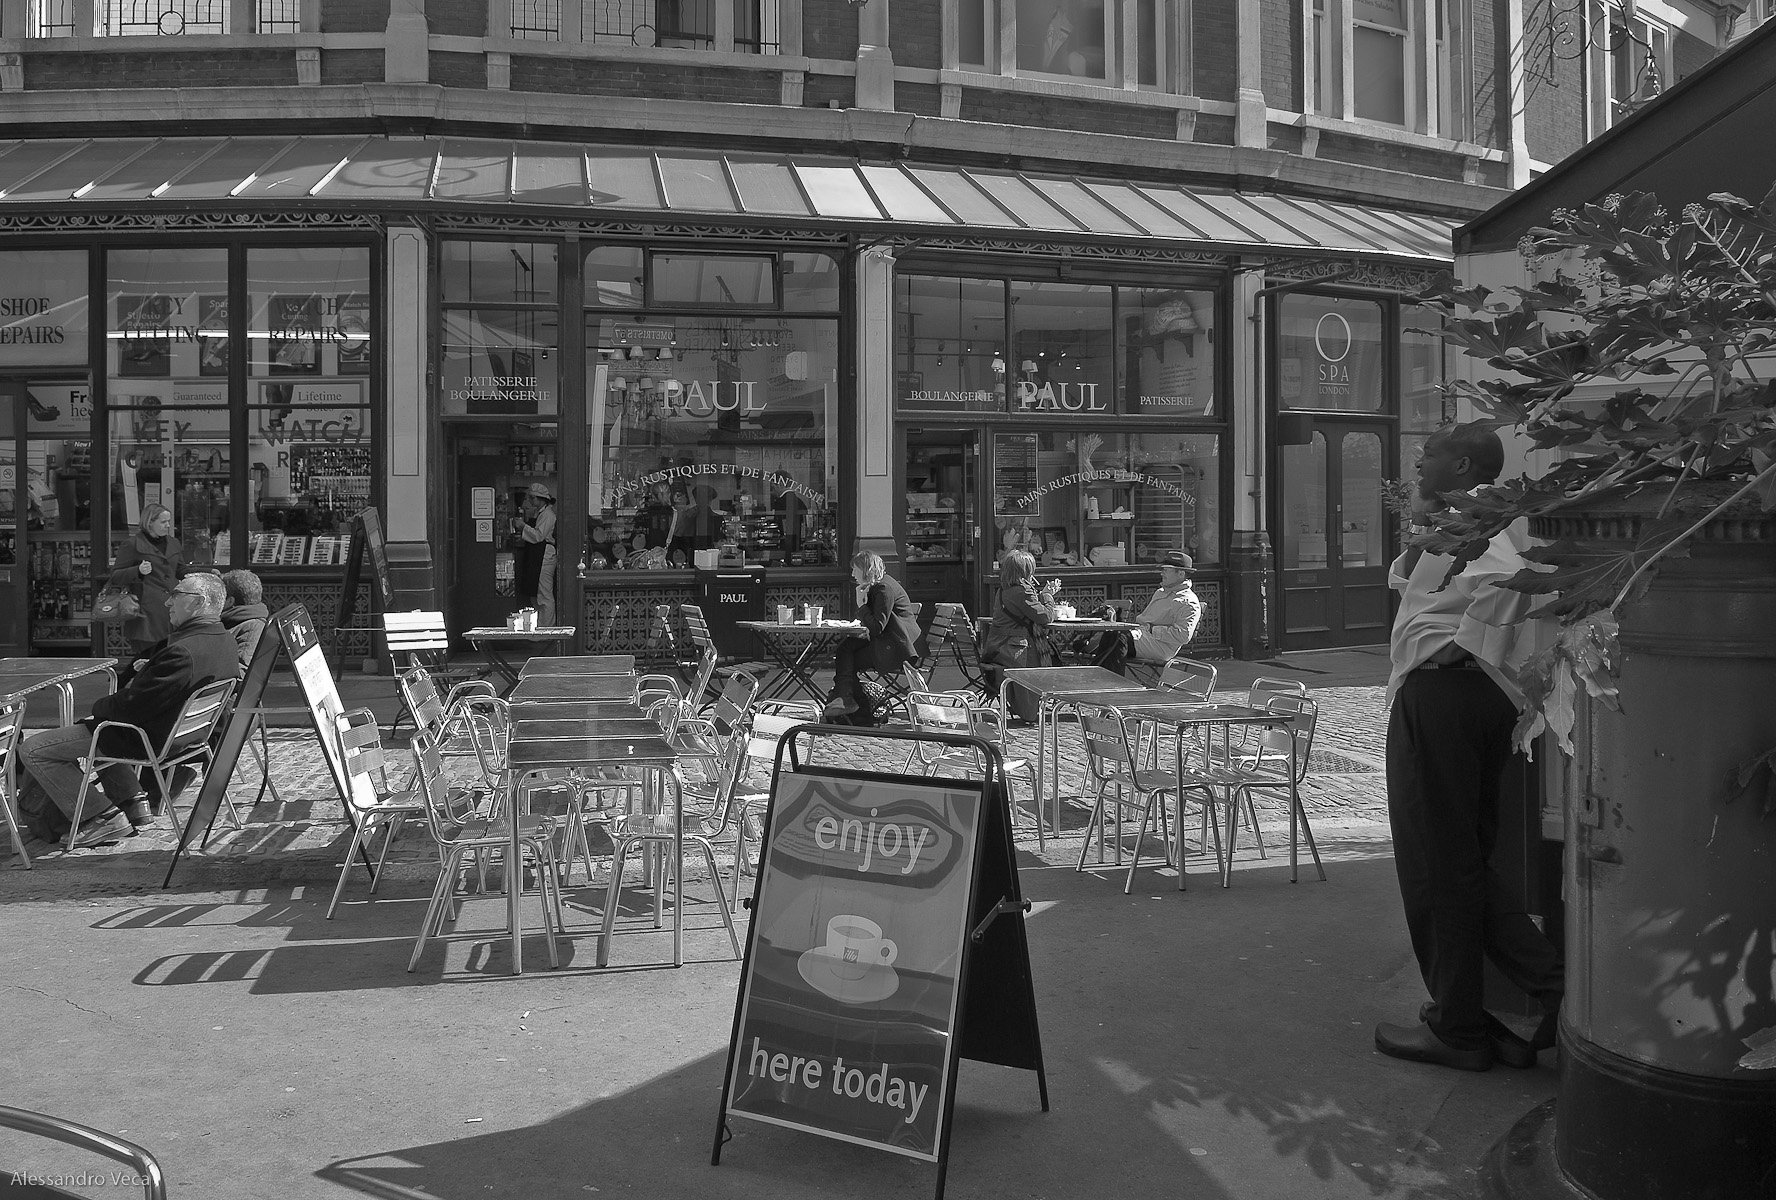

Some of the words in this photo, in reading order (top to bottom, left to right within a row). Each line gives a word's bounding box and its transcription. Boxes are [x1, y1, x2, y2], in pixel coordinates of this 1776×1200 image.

[0, 297, 50, 316] SHOE
[269, 326, 349, 344] REPAIRS
[1315, 312, 1351, 362] O
[463, 376, 538, 387] PATISSERIE
[1319, 364, 1349, 382] SPA
[174, 391, 223, 401] Guaranteed
[298, 391, 343, 402] Lifetime
[450, 389, 551, 401] BOULANGERIE
[659, 380, 768, 411] PAUL
[910, 390, 994, 402] BOULANGERIE
[1017, 381, 1107, 411] PAUL
[1319, 386, 1350, 395] LONDON
[1140, 396, 1194, 406] PATISSERIE
[259, 419, 363, 447] WATCH
[640, 463, 717, 487] RUSTIQUES
[721, 464, 739, 475] ET
[741, 466, 760, 479] DE
[763, 470, 826, 506] FANTAISIE
[1017, 485, 1048, 509] PAINS
[1048, 469, 1111, 491] RUSTIQUES
[1114, 470, 1128, 480] ET
[1130, 471, 1145, 483] DE
[1147, 475, 1198, 507] FANTAISIE
[720, 593, 748, 603] PAUL
[815, 807, 930, 875] enjoy
[748, 1036, 823, 1089] here
[832, 1057, 929, 1124] today
